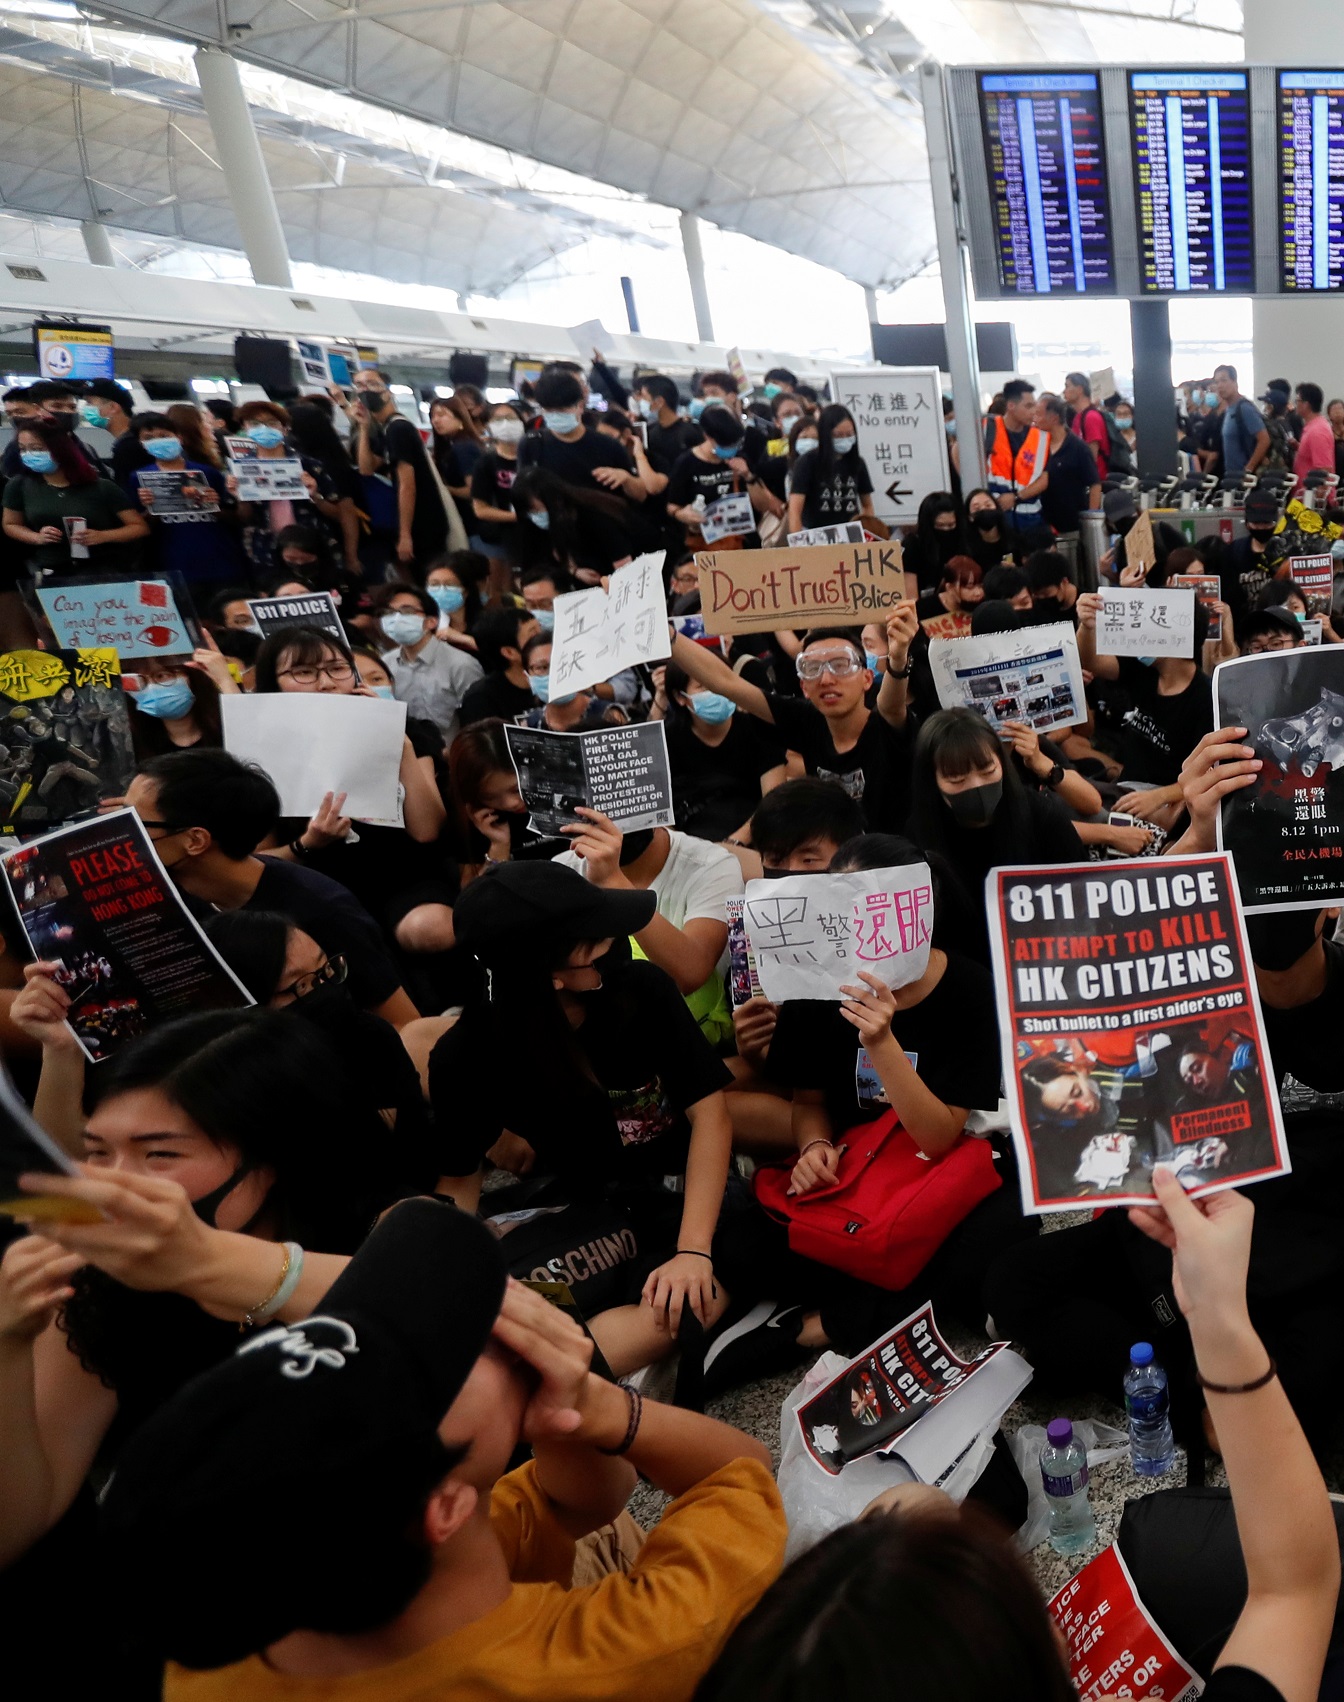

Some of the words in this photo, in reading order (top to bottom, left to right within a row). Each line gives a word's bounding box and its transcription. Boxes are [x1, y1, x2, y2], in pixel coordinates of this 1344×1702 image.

[845, 392, 930, 412] 不准進入
[860, 414, 880, 426] No
[884, 414, 919, 428] entry
[875, 442, 913, 460] 出口
[883, 462, 908, 475] Exit
[854, 547, 900, 579] HK
[1307, 558, 1330, 568] POLICE
[711, 569, 782, 613] Don't
[781, 561, 852, 605] Trust
[1305, 573, 1331, 583] CITIZENS
[54, 595, 84, 612] Can
[94, 598, 128, 618] you
[849, 582, 903, 610] Police
[255, 605, 280, 620] 811
[278, 599, 330, 618] POLICE
[64, 614, 117, 635] imagine
[124, 611, 145, 626] the
[151, 611, 177, 627] pain
[67, 631, 80, 648] of
[96, 631, 134, 649] losing
[584, 735, 599, 746] HK
[601, 729, 639, 744] POLICE
[585, 744, 608, 756] FIRE
[611, 741, 632, 751] THE
[587, 753, 615, 765] TEAR
[617, 749, 638, 760] GAS
[588, 765, 600, 775] IN
[600, 759, 628, 773] YOUR
[629, 756, 653, 767] FACE
[589, 774, 605, 785] NO
[607, 766, 648, 781] MATTER
[591, 782, 613, 793] YOU
[615, 778, 636, 788] ARE
[592, 783, 656, 803] PROTESTERS
[593, 794, 648, 812] RESIDENTS
[649, 790, 663, 800] OR
[1294, 786, 1326, 804] 黑警
[602, 801, 658, 819] ASSENGERS
[1294, 804, 1327, 821] 還眼
[1281, 825, 1306, 837] 8.12
[1312, 824, 1340, 838] 1pm
[69, 841, 144, 886] PLEASE
[82, 888, 98, 902] DO
[96, 881, 115, 897] NOT
[114, 874, 140, 891] COME
[138, 869, 153, 883] TO
[1008, 882, 1076, 923] 811
[1085, 870, 1220, 919] POLICE
[90, 897, 128, 923] HONG
[127, 886, 165, 910] KONG
[746, 885, 931, 967] 黑警還眼
[1014, 933, 1117, 962] ATTEMPT
[1123, 929, 1155, 953] TO
[1160, 910, 1227, 949] KILL
[1016, 966, 1068, 1003] HK
[1076, 943, 1235, 1001] CITIZENS
[1023, 1018, 1058, 1033] Shot
[1060, 1013, 1103, 1032] bullet
[1104, 1013, 1120, 1029] to
[1122, 1014, 1132, 1026] a
[1132, 1003, 1165, 1025] first
[1166, 998, 1216, 1020] aider's
[1217, 991, 1244, 1011] eye
[1175, 1102, 1247, 1129] Permanent
[1179, 1116, 1245, 1141] Blindness
[524, 1228, 638, 1287] OSCHINO
[912, 1318, 939, 1359] 811
[880, 1342, 903, 1376] HK
[895, 1334, 934, 1387] ATTEMPT
[1073, 1599, 1111, 1648] FACE
[1133, 1655, 1163, 1687] OR
